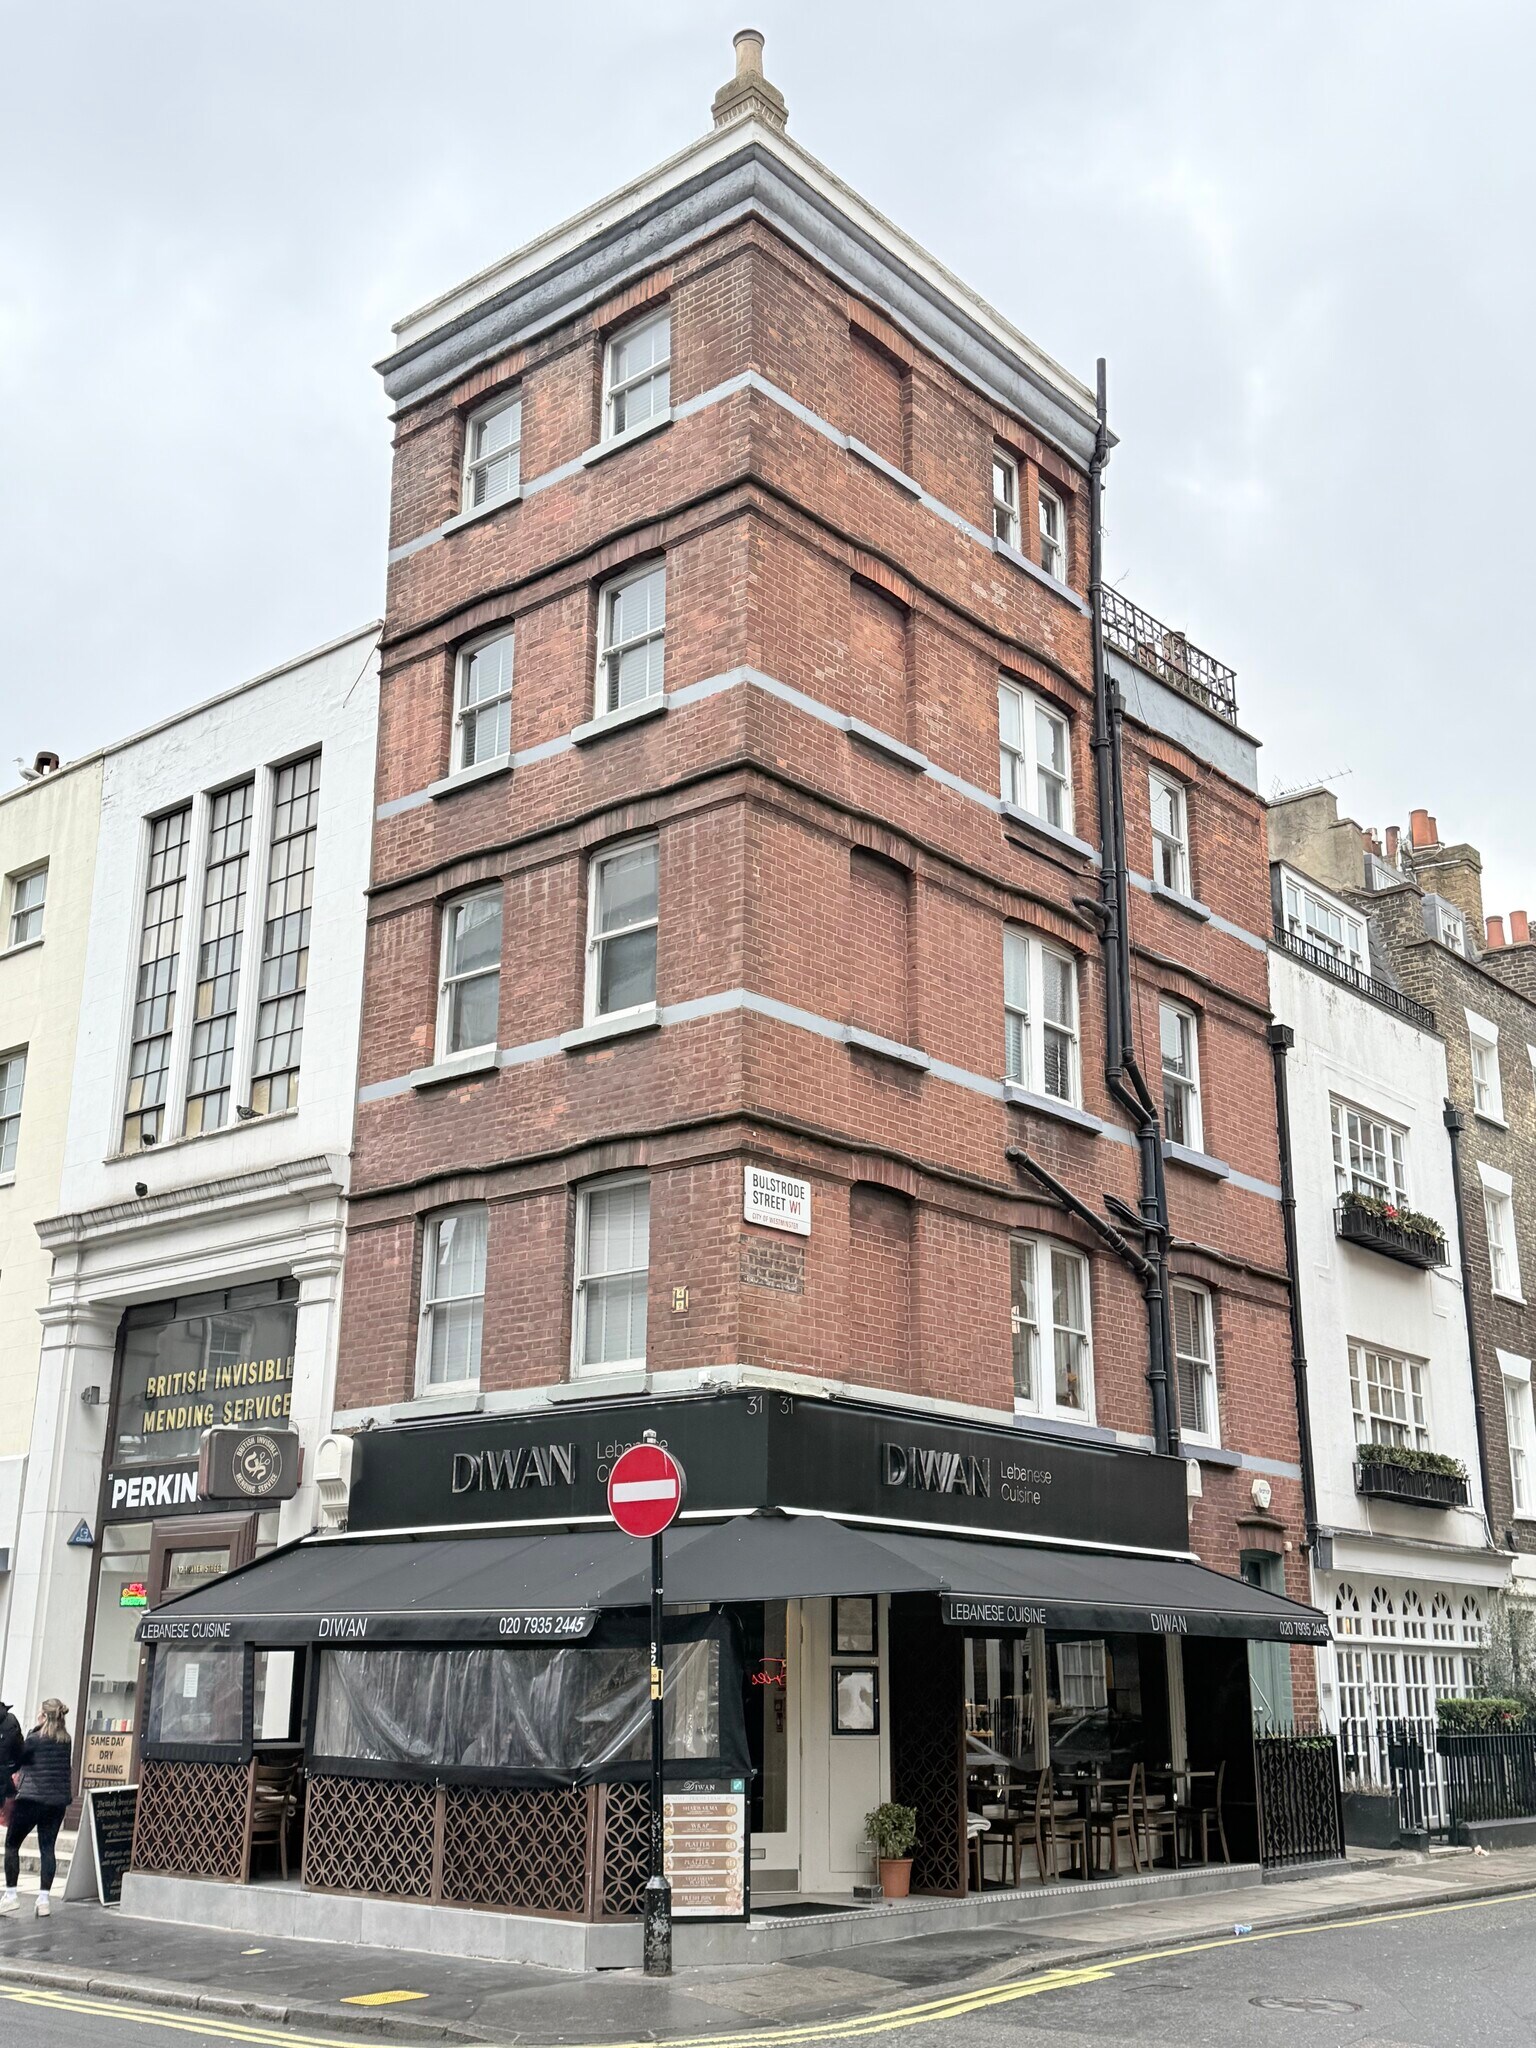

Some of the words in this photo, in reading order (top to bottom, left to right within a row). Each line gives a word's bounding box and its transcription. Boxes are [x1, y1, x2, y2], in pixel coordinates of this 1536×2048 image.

[753, 1173, 805, 1200] BULSTRODE
[753, 1190, 786, 1211] STREET
[789, 1200, 801, 1215] W1
[752, 1212, 762, 1220] CITY
[762, 1214, 768, 1222] OF
[769, 1216, 799, 1230] WESTMINSTER
[146, 1369, 207, 1399] BRITISH
[214, 1356, 294, 1389] INVISIBLE
[142, 1404, 214, 1434] MENDING
[223, 1393, 291, 1425] SERVICE
[747, 1395, 763, 1415] 31
[780, 1396, 793, 1415] 31
[236, 1437, 256, 1457] BRITISH
[256, 1436, 279, 1457] INVISIBLE
[452, 1442, 577, 1494] DIWAN
[882, 1442, 991, 1498] DIWAN
[1000, 1461, 1052, 1485] Lebanese
[111, 1471, 202, 1509] PERKIN
[235, 1472, 256, 1494] MENDING
[257, 1473, 278, 1493] SERVICE
[1001, 1483, 1041, 1505] Cuisine
[950, 1603, 1005, 1622] LEBANESE
[1006, 1605, 1047, 1624] CUISINE
[1150, 1613, 1188, 1634] DIWAN
[141, 1624, 190, 1639] LEBANESE
[191, 1623, 231, 1638] CUISINE
[318, 1617, 368, 1637] DIWAN
[499, 1617, 521, 1634] 020
[523, 1617, 553, 1634] 7935
[554, 1616, 586, 1634] 2445
[1279, 1621, 1294, 1635] 020
[1293, 1621, 1312, 1636] 7935
[1311, 1623, 1330, 1637] 2445
[90, 1736, 110, 1746] SAME
[110, 1736, 125, 1747] DAY
[99, 1750, 114, 1760] DRY
[87, 1763, 124, 1775] CLEANING
[681, 1780, 716, 1791] DIWAN
